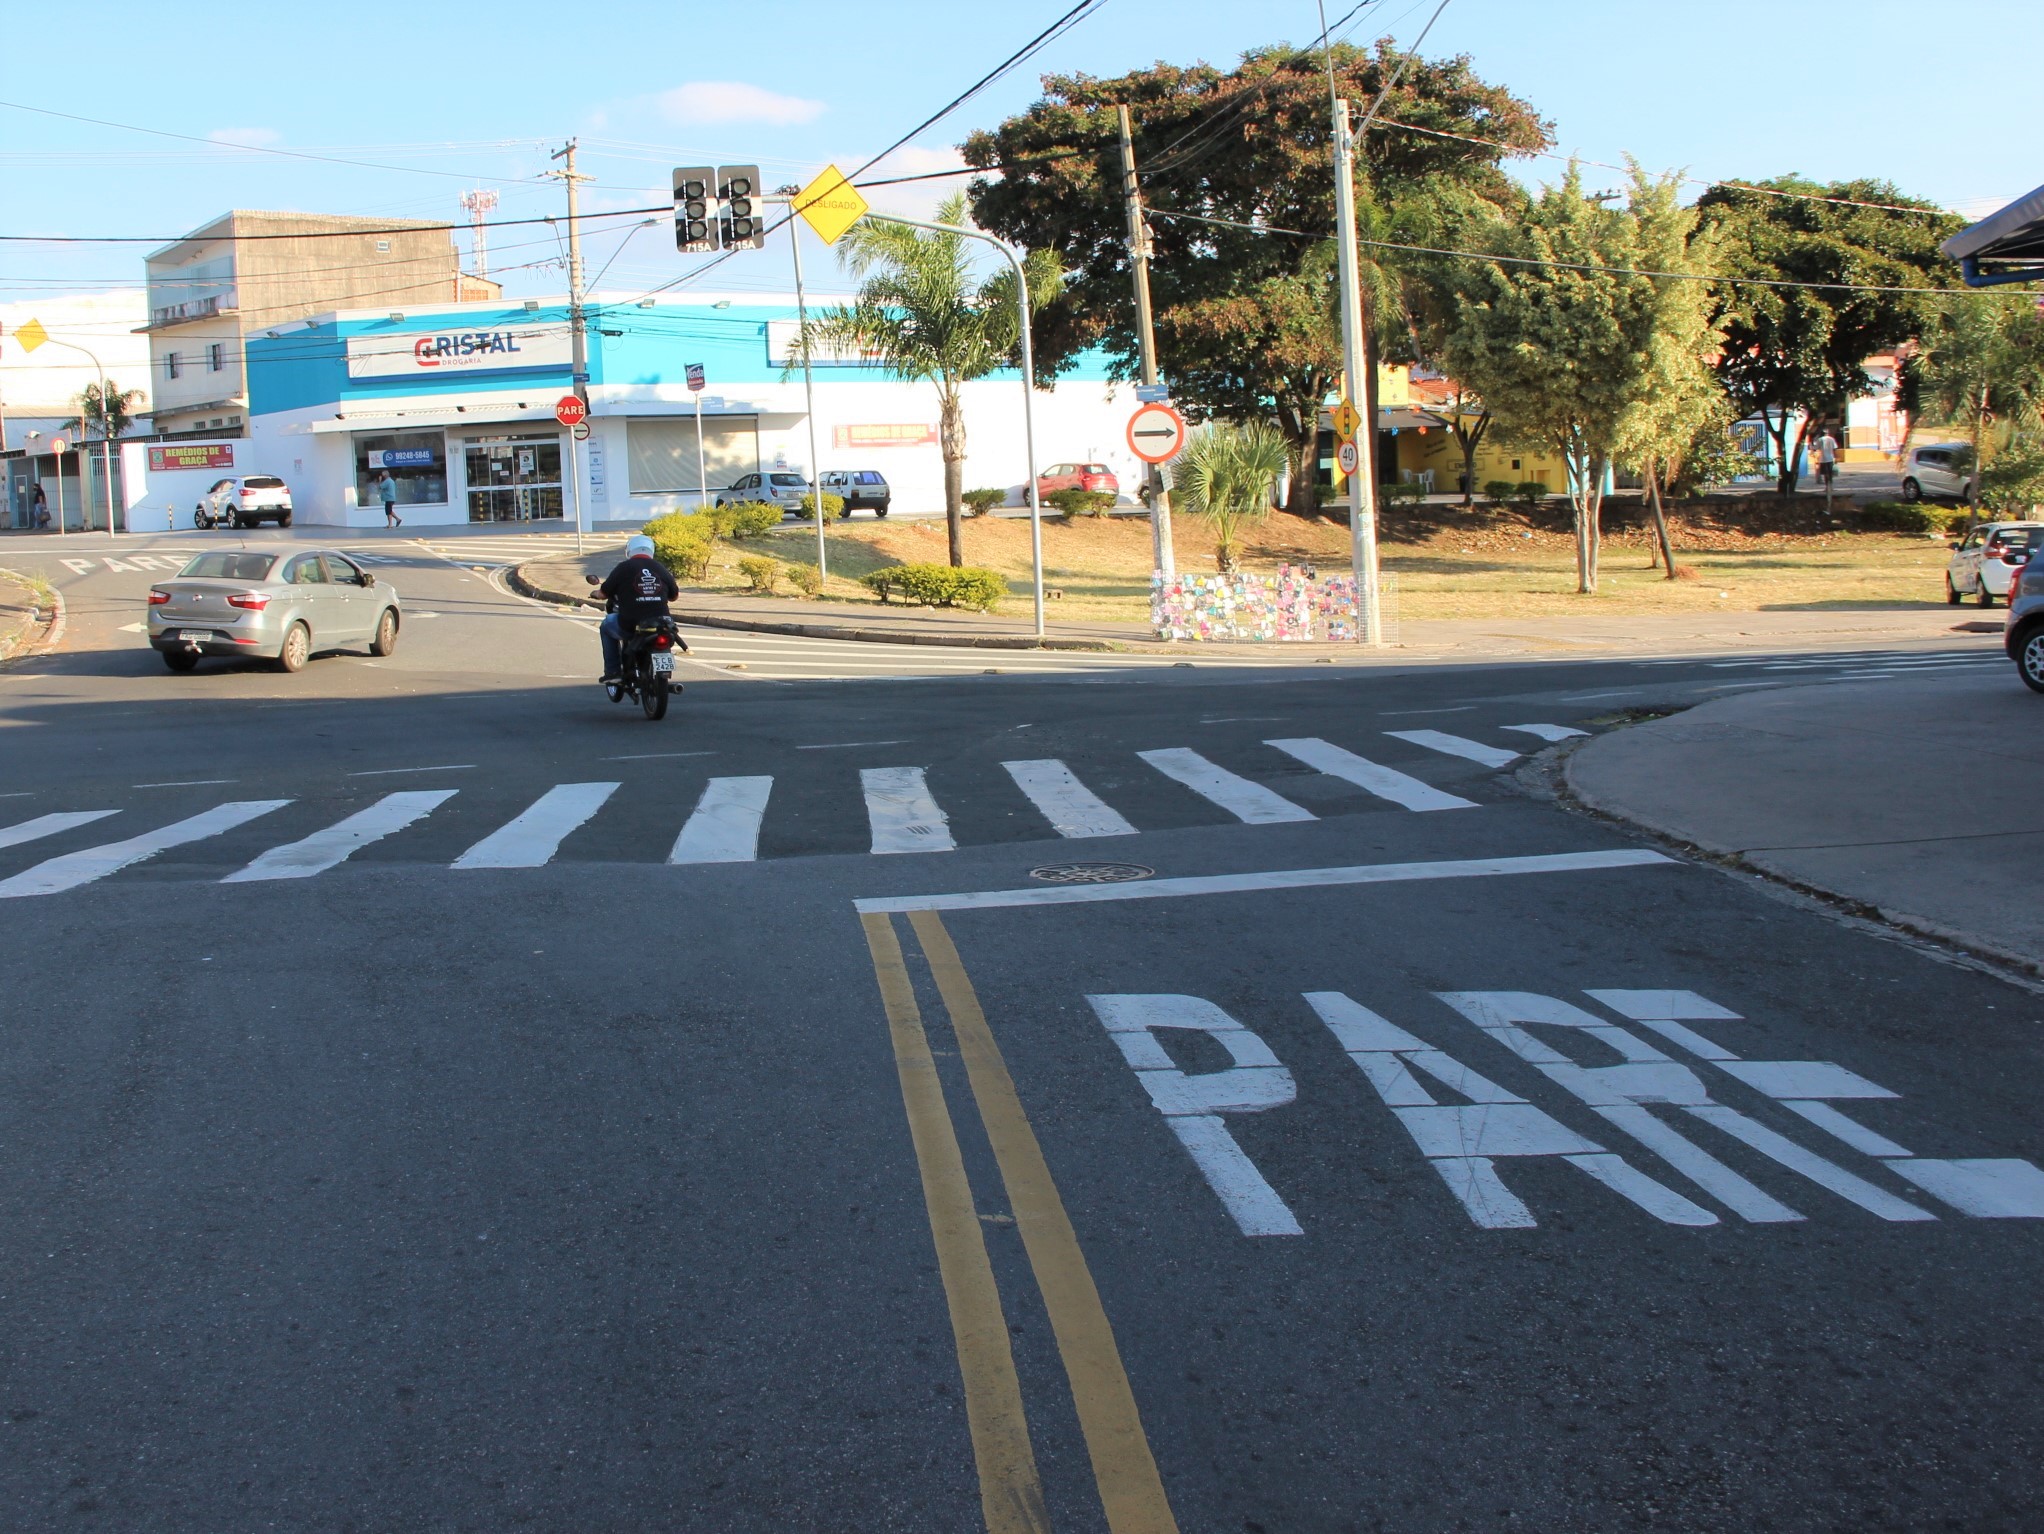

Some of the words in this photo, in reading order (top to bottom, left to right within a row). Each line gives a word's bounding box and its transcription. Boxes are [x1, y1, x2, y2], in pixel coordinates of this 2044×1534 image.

[805, 199, 857, 210] DESLIGADO
[685, 242, 712, 252] 715A
[730, 240, 756, 250] 715A
[442, 357, 482, 366] DROGARIA
[557, 405, 584, 416] PARE
[165, 447, 208, 457] REMÉDIOS
[209, 446, 220, 455] DE
[1342, 447, 1354, 461] 40
[179, 456, 208, 465] GRAÇA
[1084, 988, 2044, 1236] PARE
